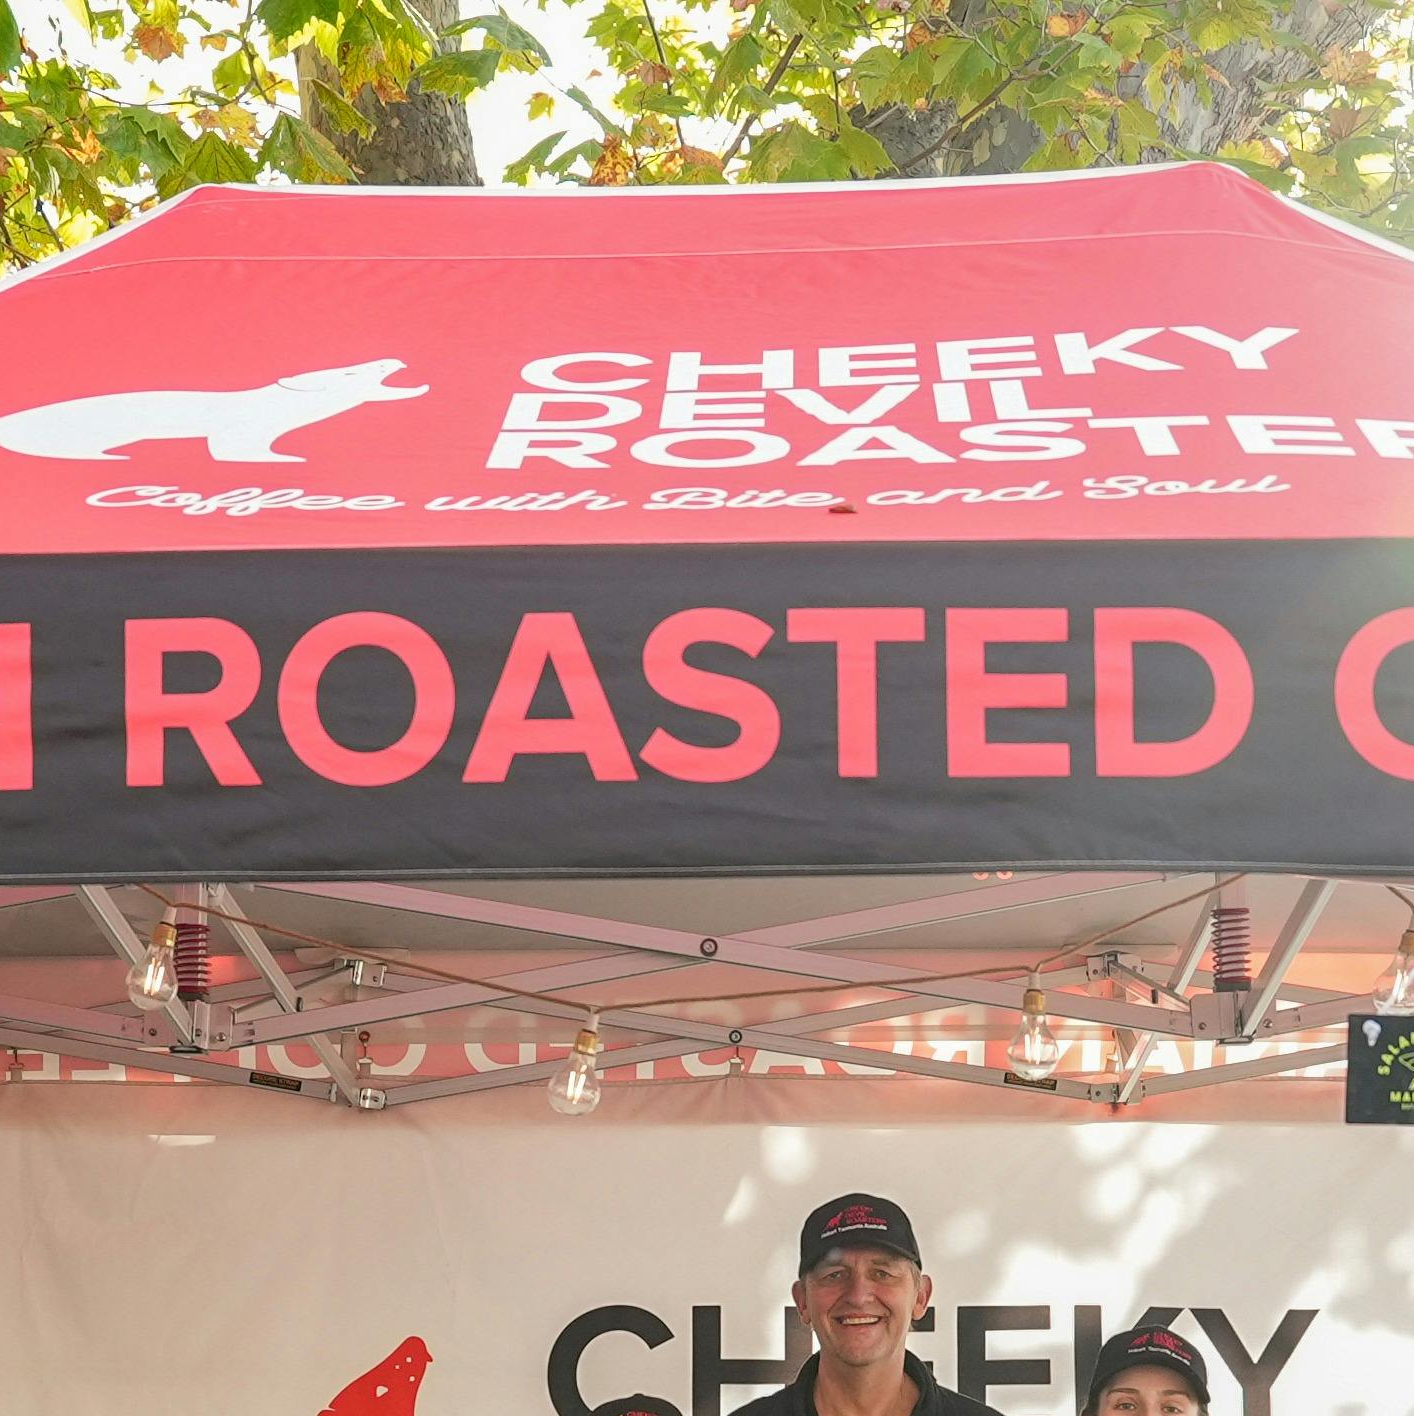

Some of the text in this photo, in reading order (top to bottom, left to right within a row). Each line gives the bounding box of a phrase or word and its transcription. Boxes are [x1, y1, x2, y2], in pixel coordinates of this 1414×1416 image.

[520, 327, 1300, 391] CHEEKY
[502, 380, 1092, 432] DEVIL
[85, 475, 1292, 517] Coffee with Bite and Soul
[125, 605, 1256, 788] ROASTED
